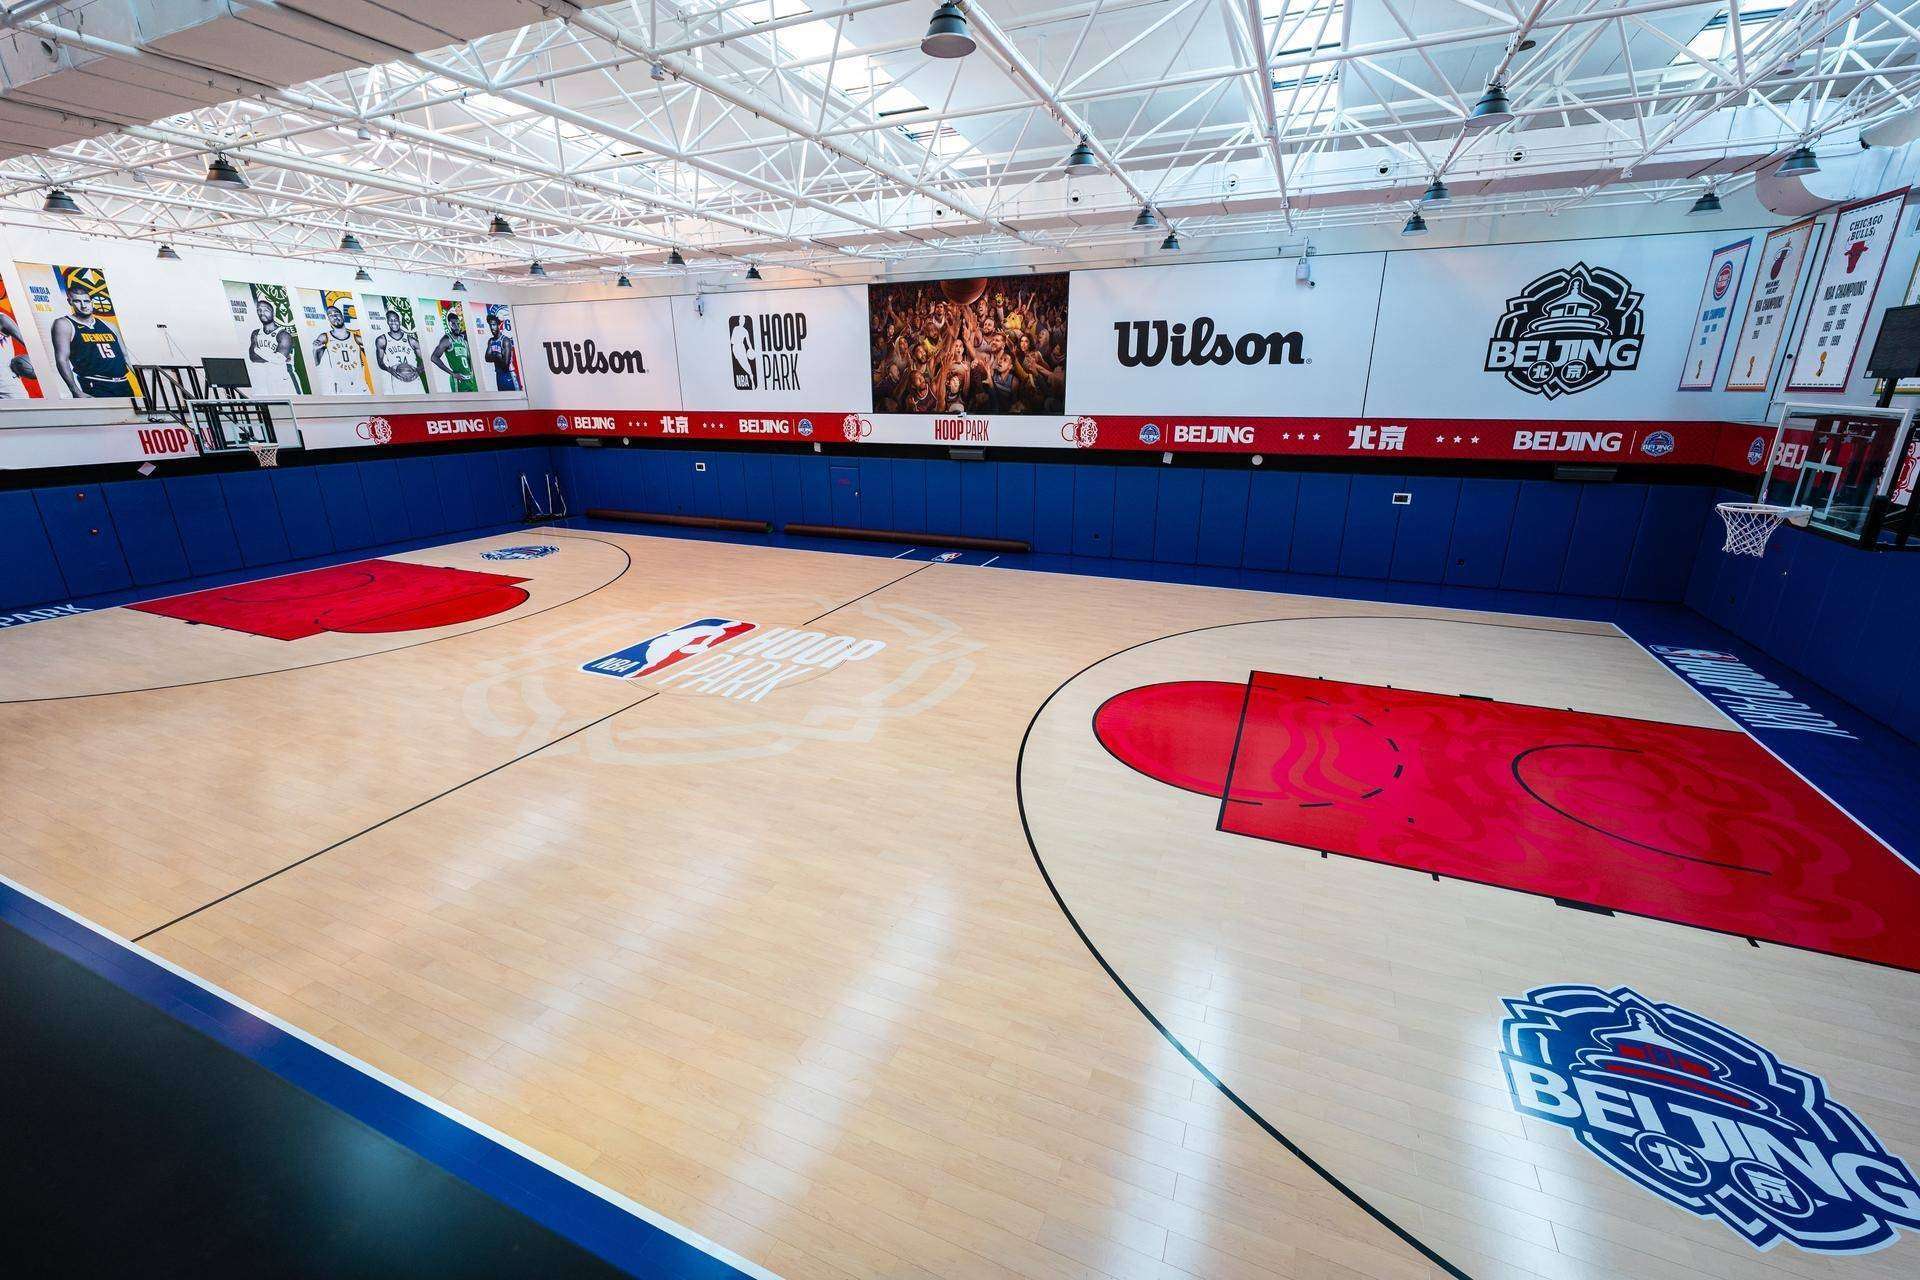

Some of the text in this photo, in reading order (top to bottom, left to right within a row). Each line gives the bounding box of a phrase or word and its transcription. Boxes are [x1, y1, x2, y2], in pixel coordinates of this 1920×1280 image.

[1849, 214, 1884, 232] CHICAGO
[1848, 226, 1876, 241] BULLS
[1835, 280, 1868, 299] CHAMPIONS
[81, 333, 115, 342] DENVER
[759, 312, 808, 352] HOOP
[96, 343, 116, 359] 15
[388, 345, 412, 355] BUCKS
[1113, 316, 1306, 368] Wilson
[342, 350, 350, 363] 0
[461, 356, 469, 369] 0
[542, 339, 647, 375] Wilson
[1487, 338, 1640, 369] BEIJING
[735, 374, 750, 388] NBA
[763, 353, 801, 391] PARK
[426, 418, 485, 435] BEIJING
[574, 416, 616, 430] BEIJING
[660, 416, 689, 434] 北京
[739, 418, 789, 434] BEIJING
[934, 419, 989, 441] HOOP PARK
[138, 428, 190, 455] HOOP
[1174, 425, 1255, 444] BEIJING
[1348, 425, 1408, 451] 北京
[1513, 430, 1623, 452] BEIJING
[1642, 443, 1674, 451] BEIJING
[727, 627, 887, 669] HOOP
[591, 657, 641, 673] NBA
[656, 653, 814, 703] PARK
[1509, 1059, 1920, 1222] BEIJING
